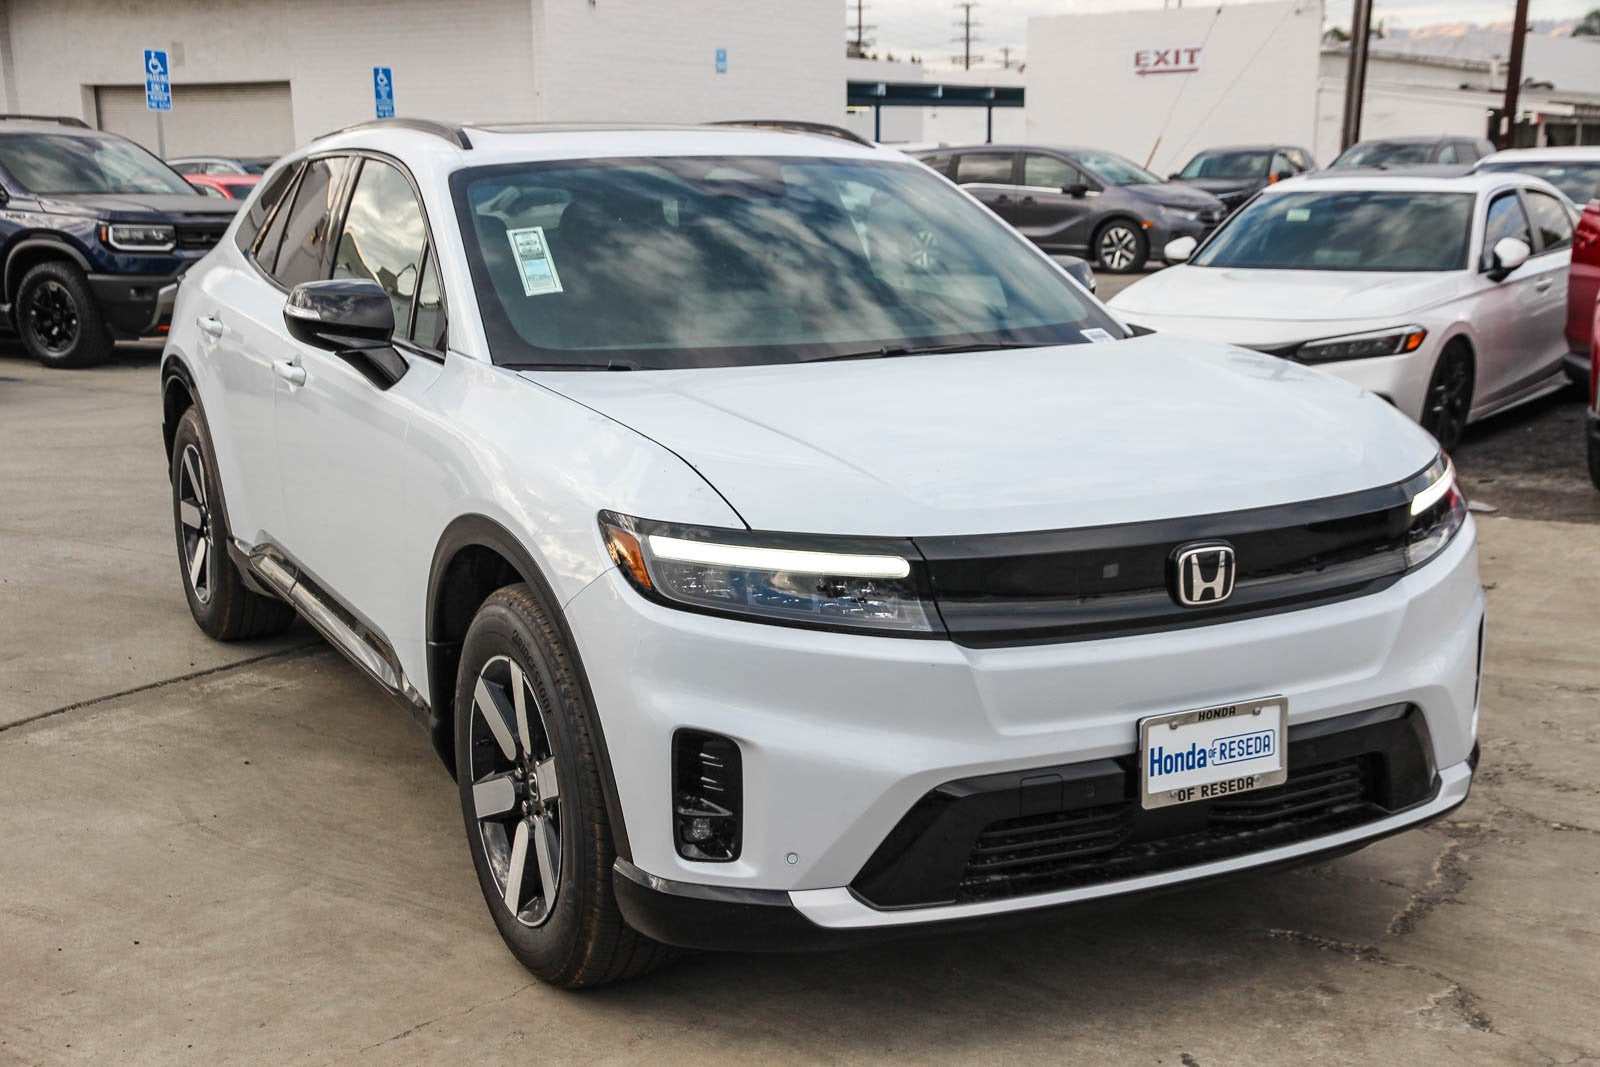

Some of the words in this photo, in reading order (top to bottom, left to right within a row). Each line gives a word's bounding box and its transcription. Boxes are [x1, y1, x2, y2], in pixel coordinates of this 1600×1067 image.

[1135, 48, 1201, 67] EXIT
[511, 629, 554, 718] BRIDGESTONE
[1198, 706, 1236, 722] HONDA
[1150, 743, 1207, 777] Honda
[1208, 747, 1217, 759] OF
[1219, 734, 1271, 761] RESEDA
[1177, 787, 1195, 802] OF
[1201, 776, 1254, 798] RESEDA
